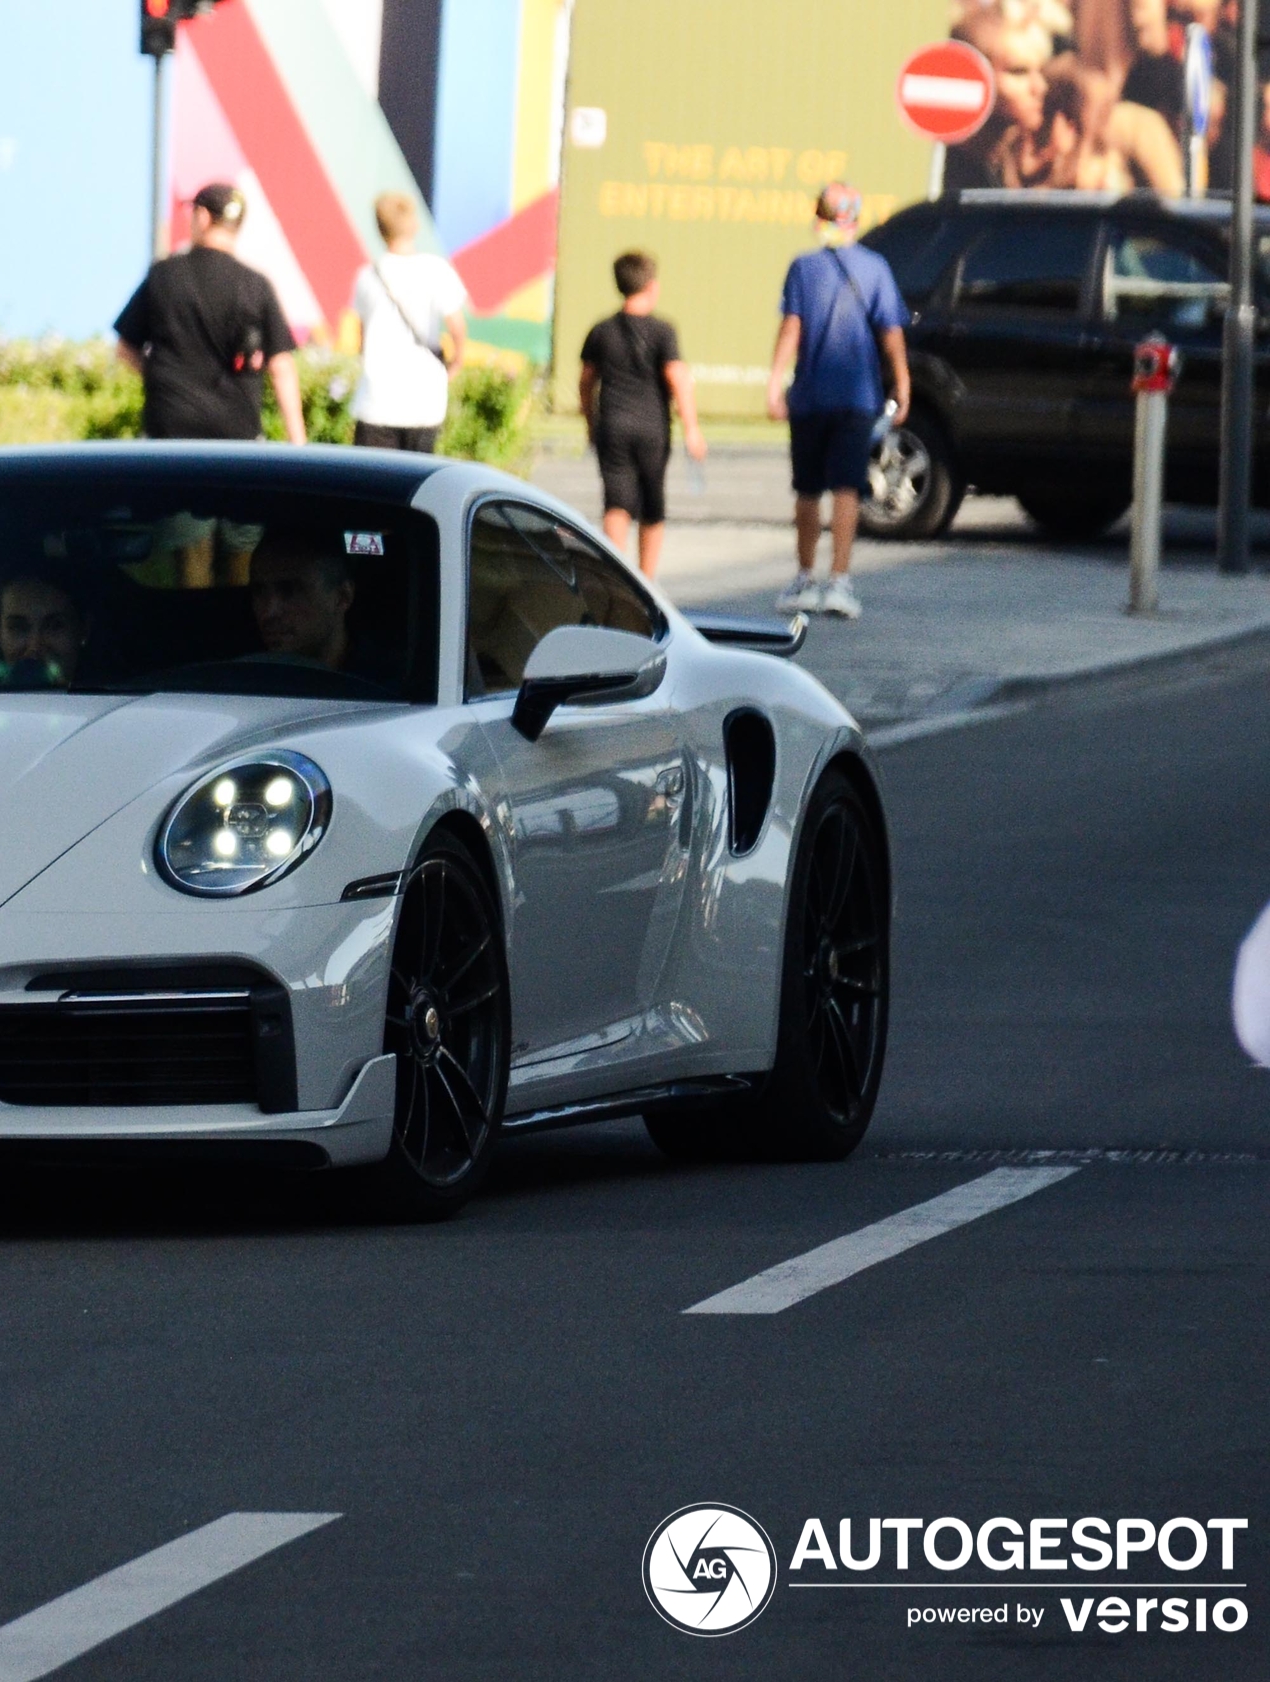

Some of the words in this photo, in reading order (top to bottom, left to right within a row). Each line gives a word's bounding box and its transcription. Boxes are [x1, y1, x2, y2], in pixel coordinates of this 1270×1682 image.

[644, 141, 713, 179] THE
[720, 146, 791, 182] ART
[797, 149, 848, 184] OF
[599, 181, 898, 225] ENTERTAINNT
